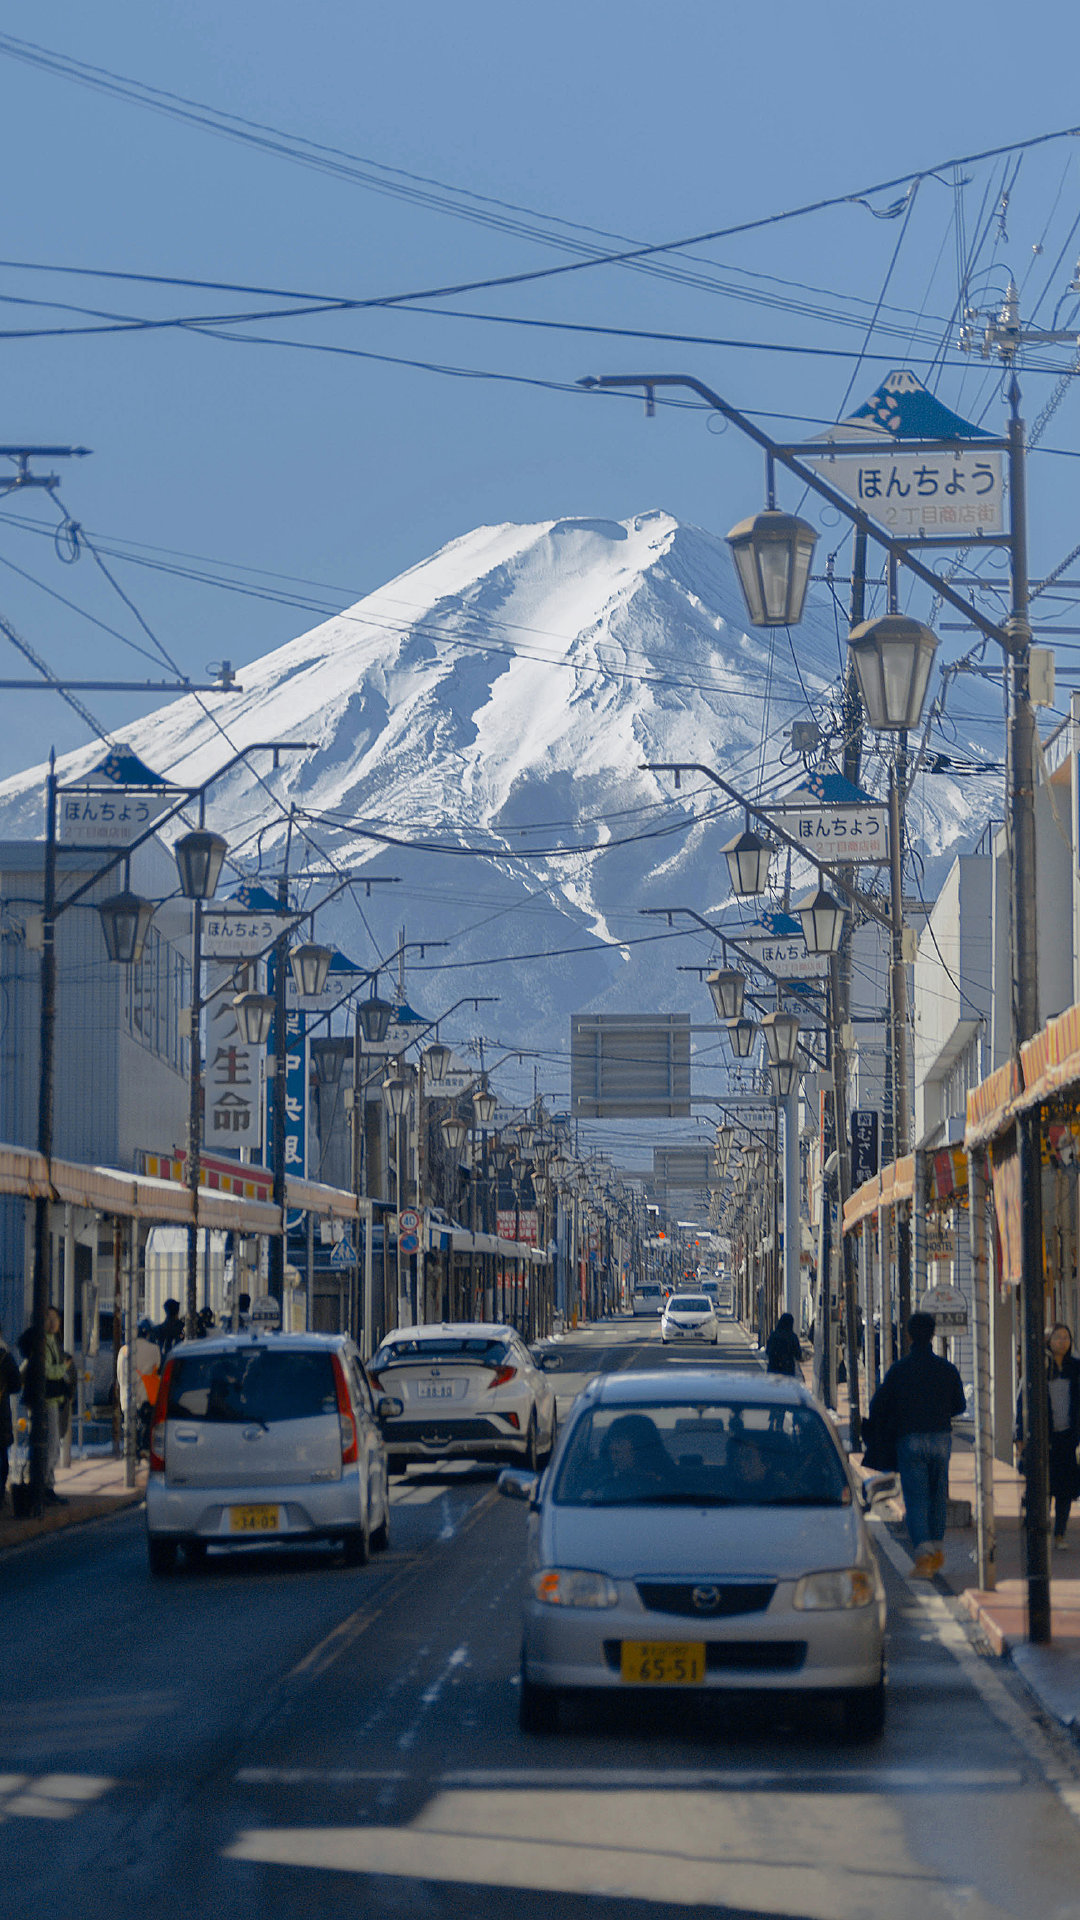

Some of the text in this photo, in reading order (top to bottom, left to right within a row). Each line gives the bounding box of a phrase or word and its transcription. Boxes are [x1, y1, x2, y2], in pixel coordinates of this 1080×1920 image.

[858, 463, 995, 499] ほんちょう
[886, 503, 996, 525] 2丁目商店街
[65, 802, 150, 822] ほんちょう
[798, 816, 880, 837] ほんちょう
[816, 840, 881, 853] 2丁目商店街
[208, 922, 273, 937] ほんちょう
[762, 945, 820, 960] ほんちょ
[404, 1215, 416, 1226] 40
